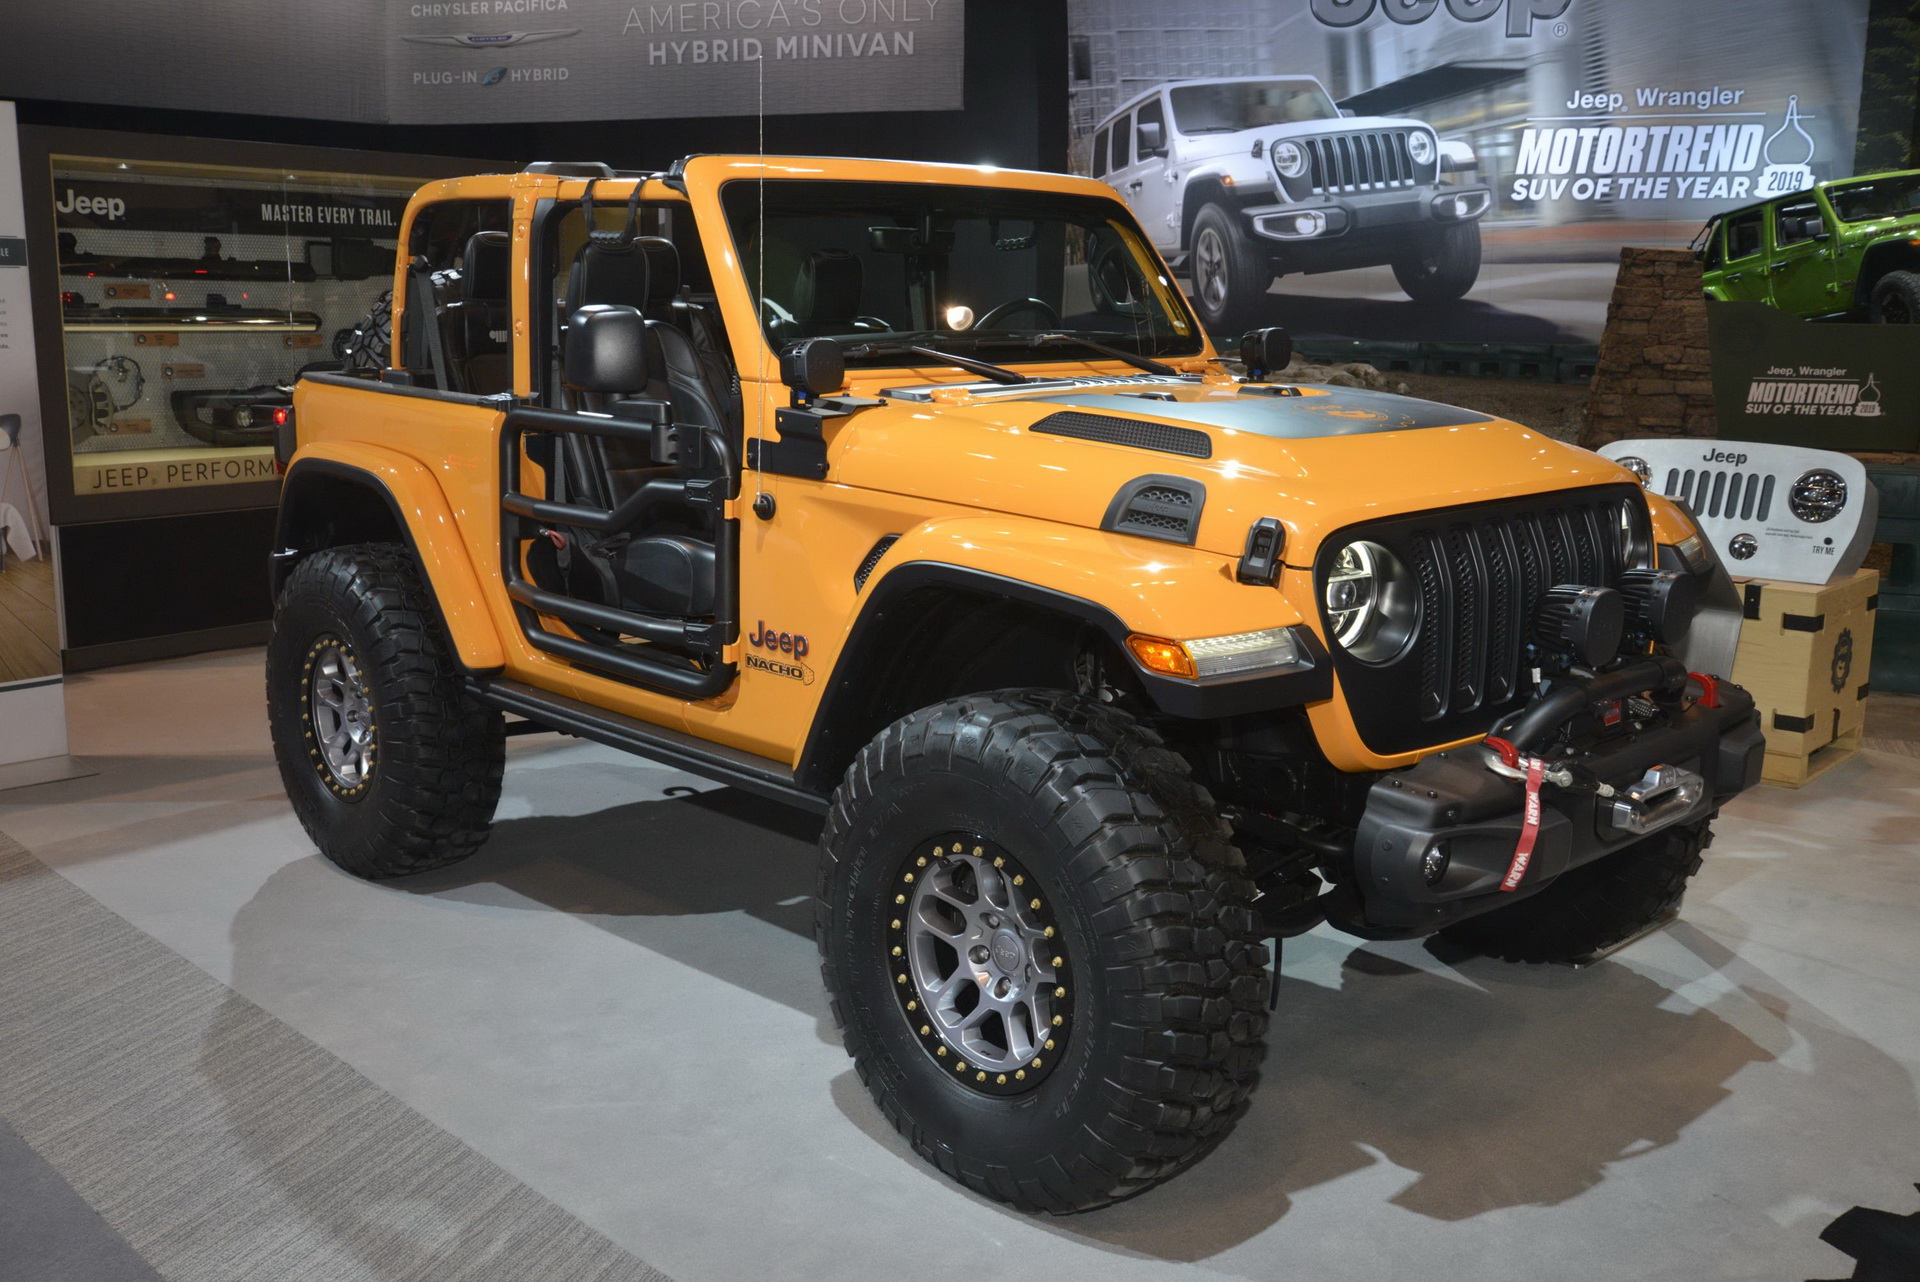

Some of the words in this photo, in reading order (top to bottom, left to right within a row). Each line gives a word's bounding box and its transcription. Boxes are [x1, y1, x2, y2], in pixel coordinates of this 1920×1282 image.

[411, 2, 489, 17] CHRYSLER
[495, 0, 568, 14] PACIFICA
[623, 0, 822, 35] AMERICA'S
[839, 0, 938, 24] ONLY
[649, 38, 763, 66] HYBRID
[776, 31, 914, 60] MINIVAN
[413, 71, 477, 85] PLUG-IN
[511, 68, 569, 82] HYBRID
[1566, 90, 1623, 112] Jeep
[1635, 87, 1745, 109] Wrangler
[1515, 124, 1765, 175] MOTORTREND
[1511, 177, 1569, 201] SUV
[1571, 177, 1614, 200] OF
[1618, 176, 1674, 199] THE
[1676, 176, 1750, 199] YEAR
[1767, 171, 1804, 191] 2019
[56, 189, 125, 220] Jeep
[261, 204, 313, 223] MASTER
[317, 206, 355, 224] EVERY
[359, 208, 397, 226] TRAIL.
[1767, 366, 1794, 377] Jeep
[1798, 366, 1848, 378] Wrangler
[1747, 382, 1860, 405] MOTORTREND
[1745, 404, 1773, 414] SUV
[1773, 404, 1792, 414] OF
[1793, 405, 1819, 415] THE
[1819, 405, 1853, 416] YEAR
[1702, 448, 1748, 467] Jeep
[93, 466, 149, 489] JEEP
[167, 458, 275, 483] PERFORM
[1812, 545, 1825, 554] TRY
[1825, 546, 1835, 556] ME
[749, 619, 809, 661] Jeep
[746, 655, 803, 679] NACHO
[1527, 791, 1539, 827] WARN
[1505, 852, 1529, 888] WARN
